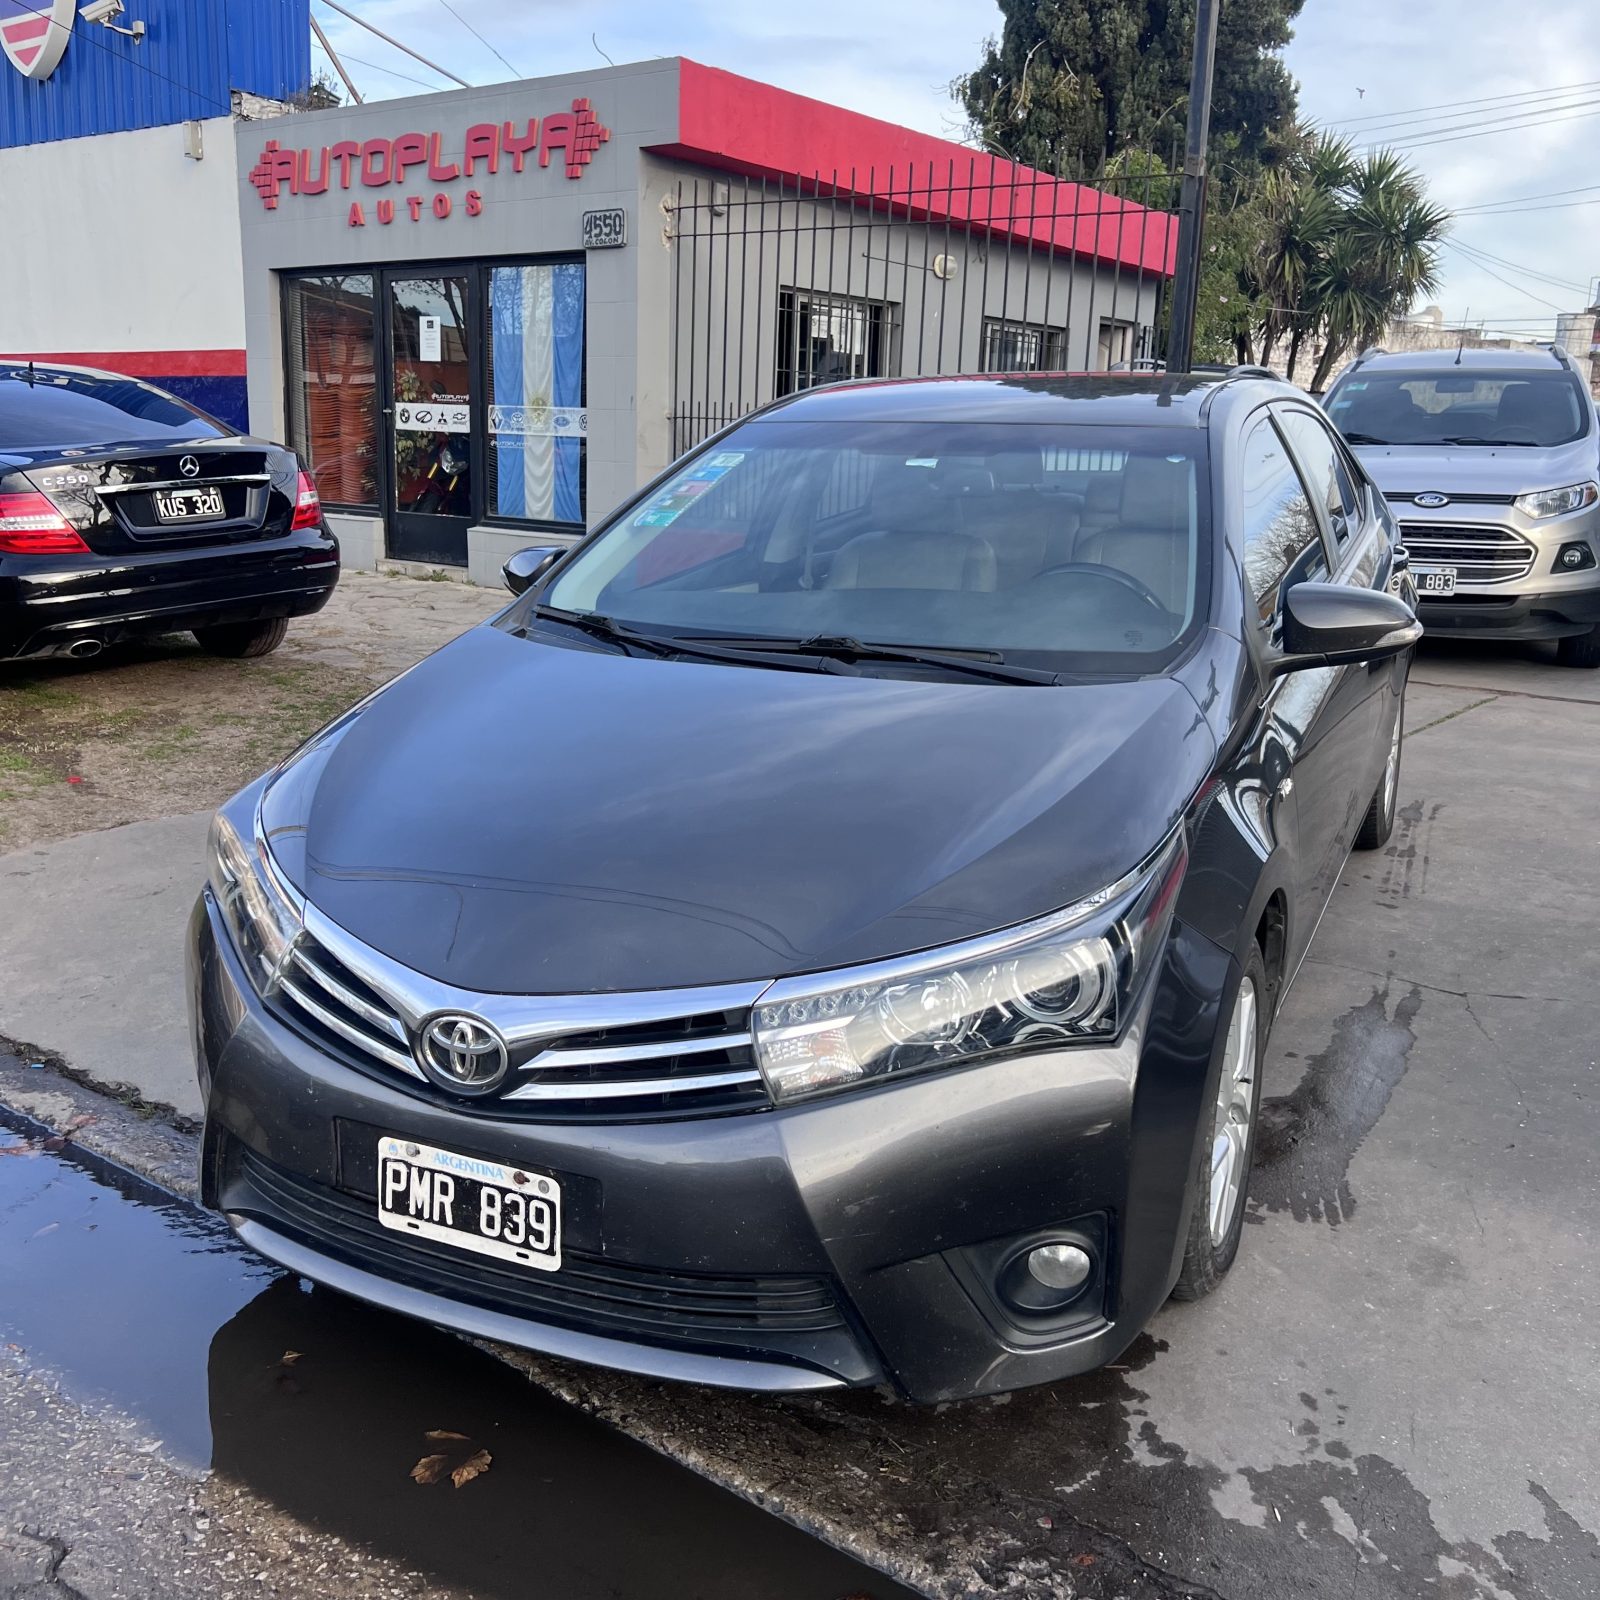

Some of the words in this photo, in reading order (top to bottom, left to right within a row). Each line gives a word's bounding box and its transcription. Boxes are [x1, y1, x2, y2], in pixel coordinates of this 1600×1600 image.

[270, 112, 577, 195] AUTOPLAYA
[348, 190, 483, 227] AUTOS
[585, 213, 622, 239] 4550
[42, 477, 52, 486] C
[56, 474, 88, 485] 250
[157, 497, 187, 517] KUS
[192, 495, 221, 514] 320
[1425, 574, 1453, 590] 883
[433, 1151, 504, 1180] ARGENTINA
[385, 1161, 455, 1225] PMR
[479, 1185, 551, 1251] 839
